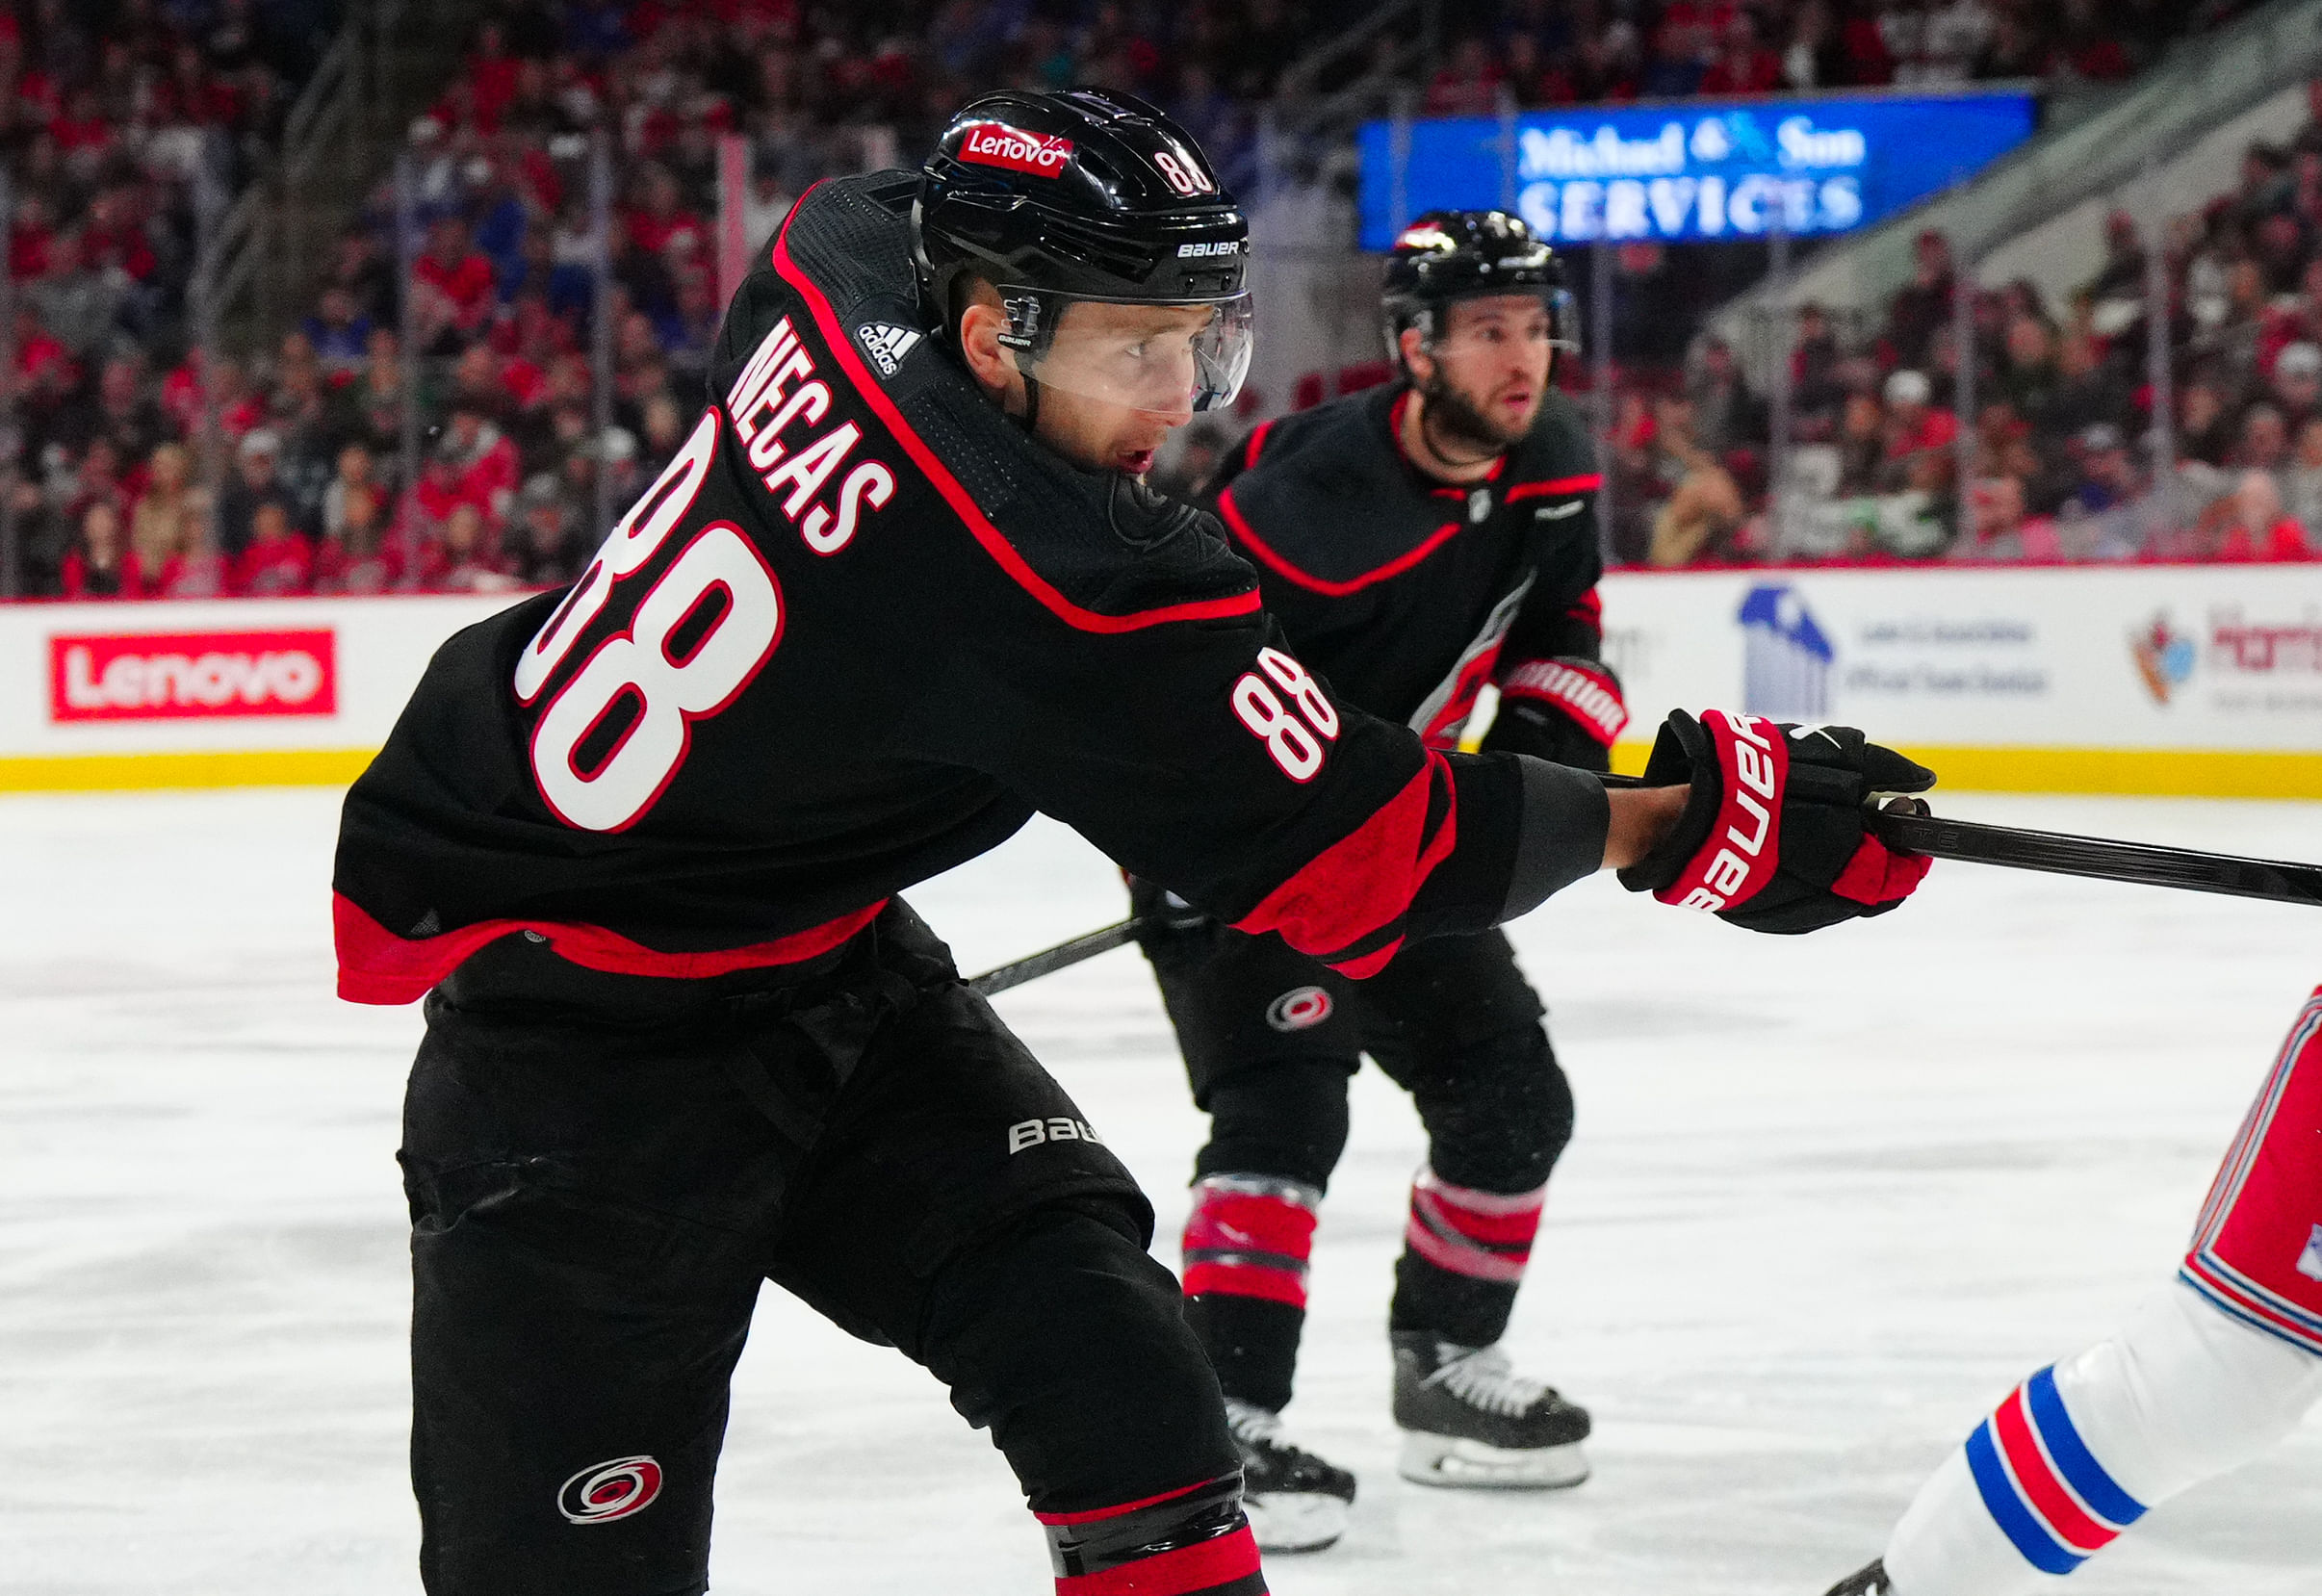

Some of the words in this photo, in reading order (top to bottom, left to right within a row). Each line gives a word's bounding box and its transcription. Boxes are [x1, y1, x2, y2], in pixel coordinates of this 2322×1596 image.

[968, 130, 1057, 167] Lenovo
[859, 325, 897, 374] adidas
[727, 315, 896, 556] NECAS
[513, 405, 786, 835] 88
[64, 644, 324, 709] Lenovo
[1229, 646, 1341, 785] 88
[1008, 1117, 1107, 1155] BAU
